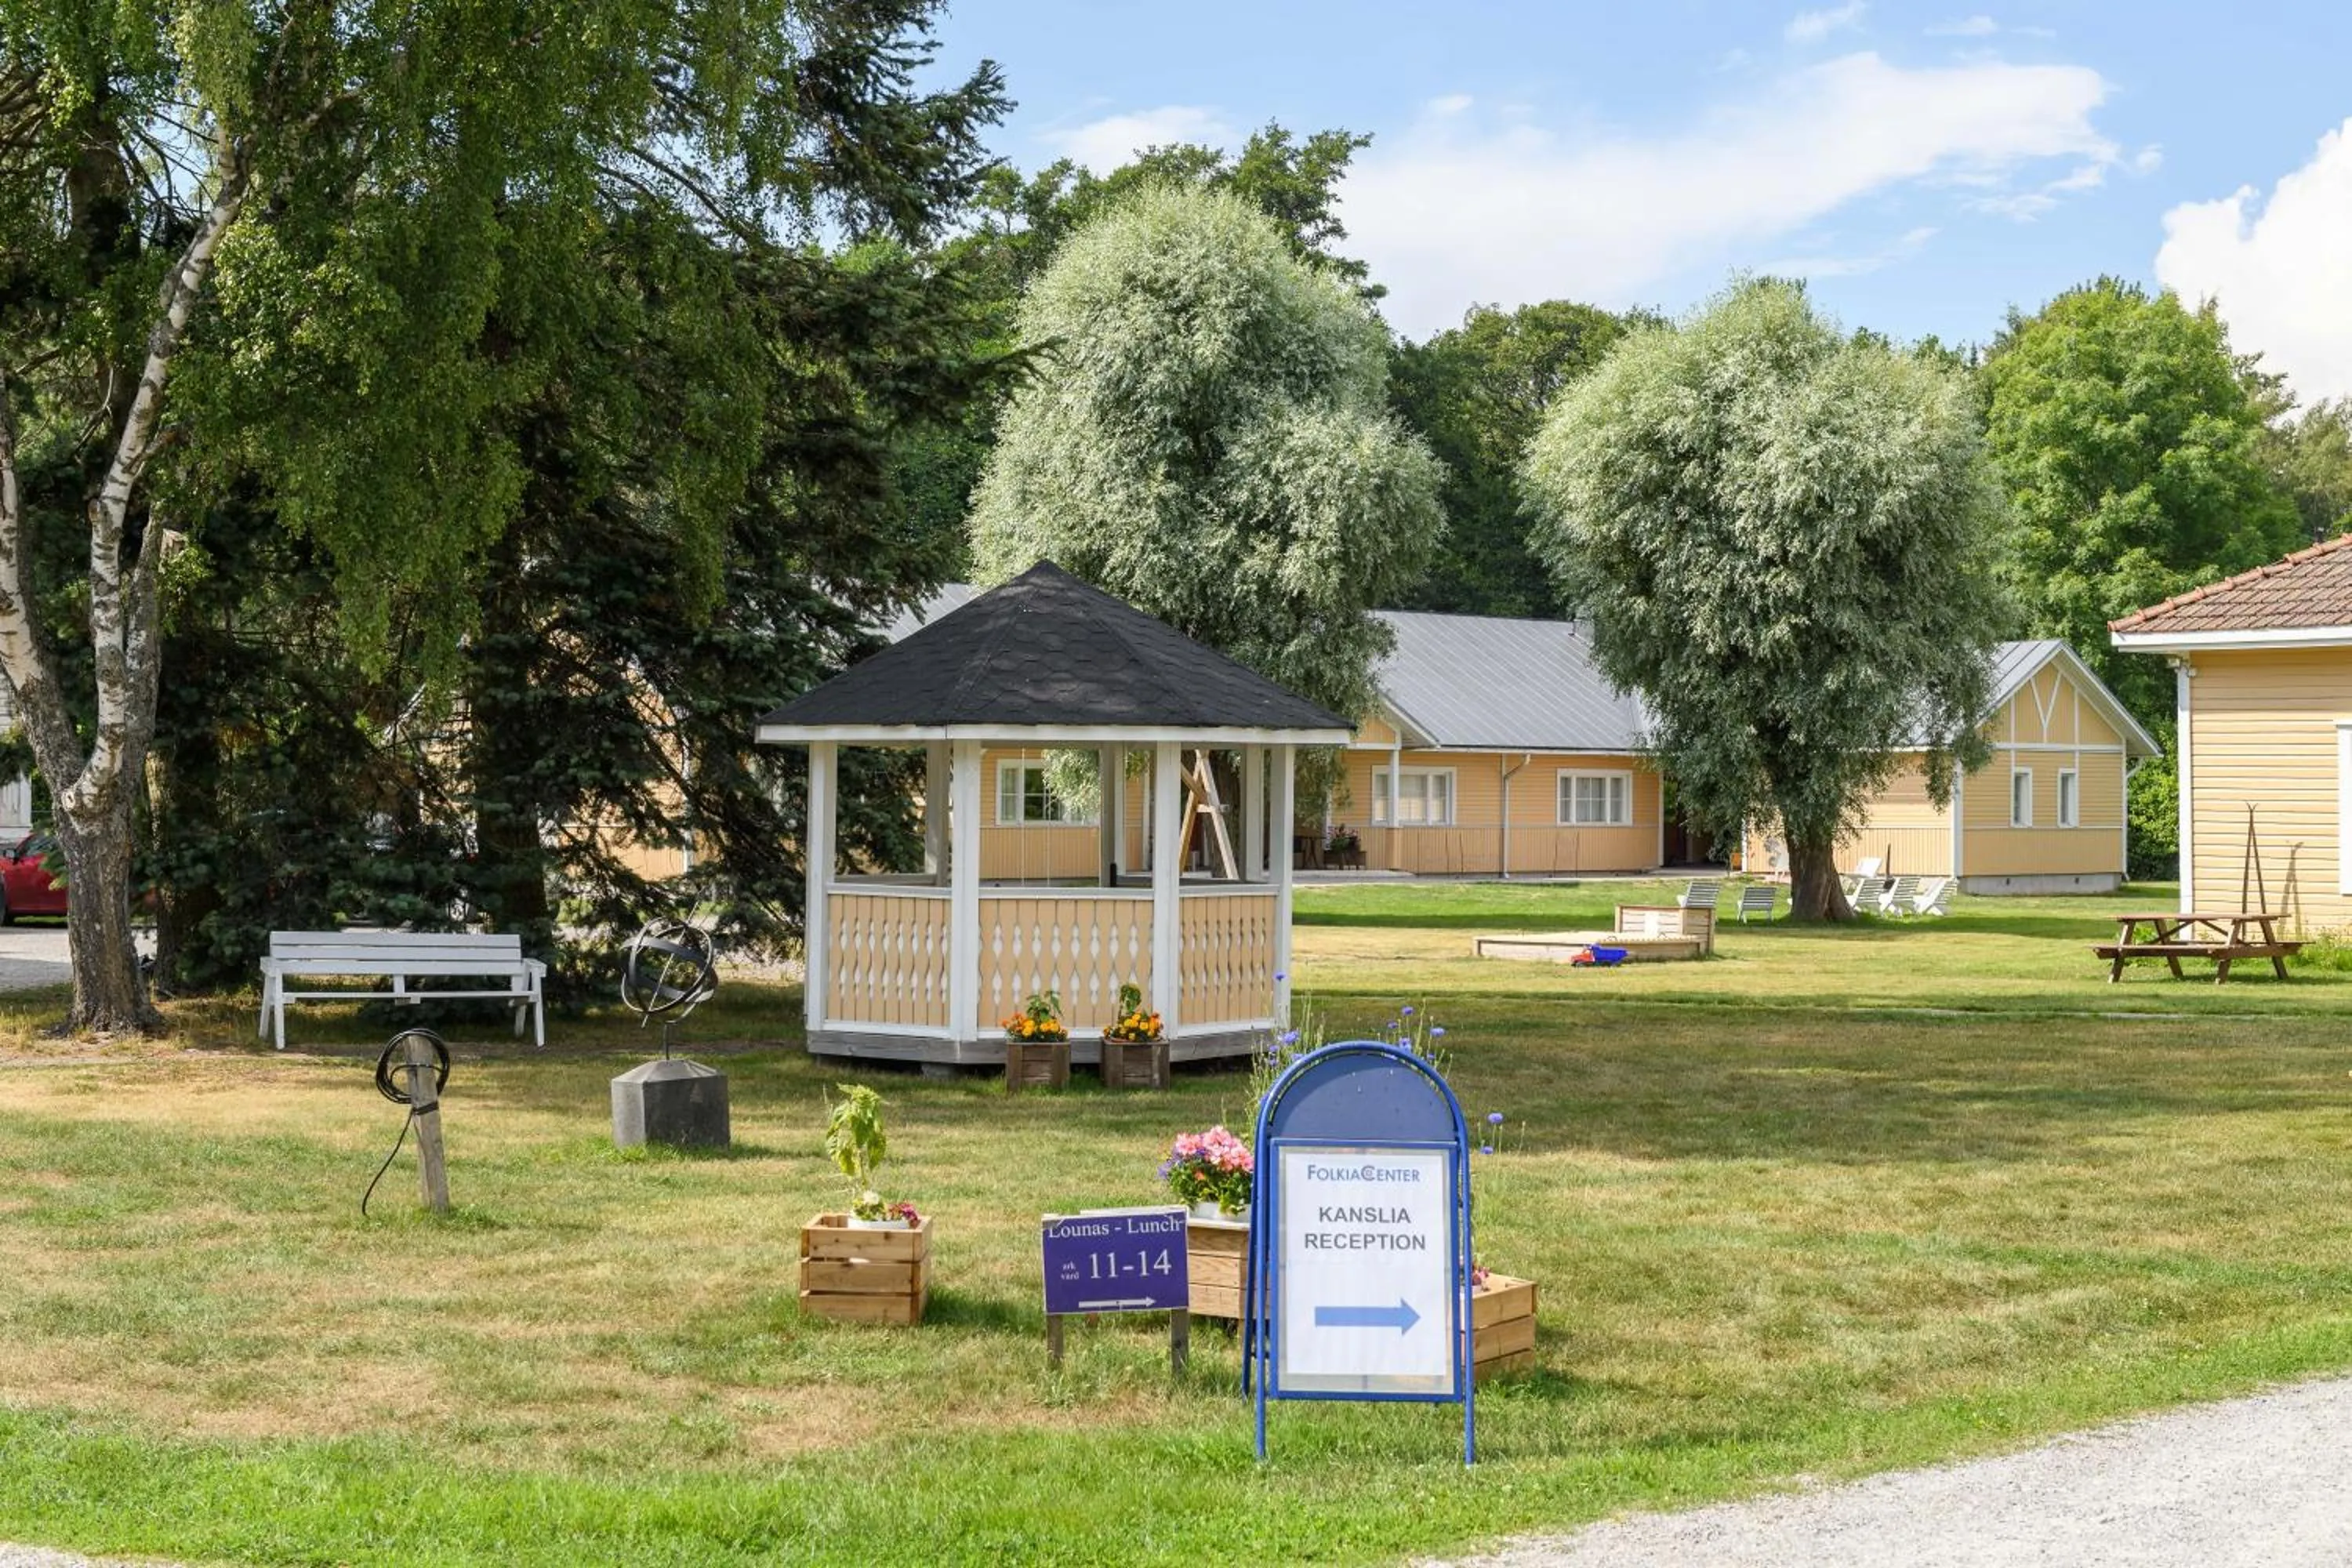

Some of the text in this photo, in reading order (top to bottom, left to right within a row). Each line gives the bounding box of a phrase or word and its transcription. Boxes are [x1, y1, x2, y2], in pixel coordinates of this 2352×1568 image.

[1319, 1207, 1411, 1224] KANSLIA
[1049, 1223, 1109, 1238] Lounas
[1305, 1232, 1426, 1250] RECEPTION
[1089, 1248, 1172, 1279] 11-14
